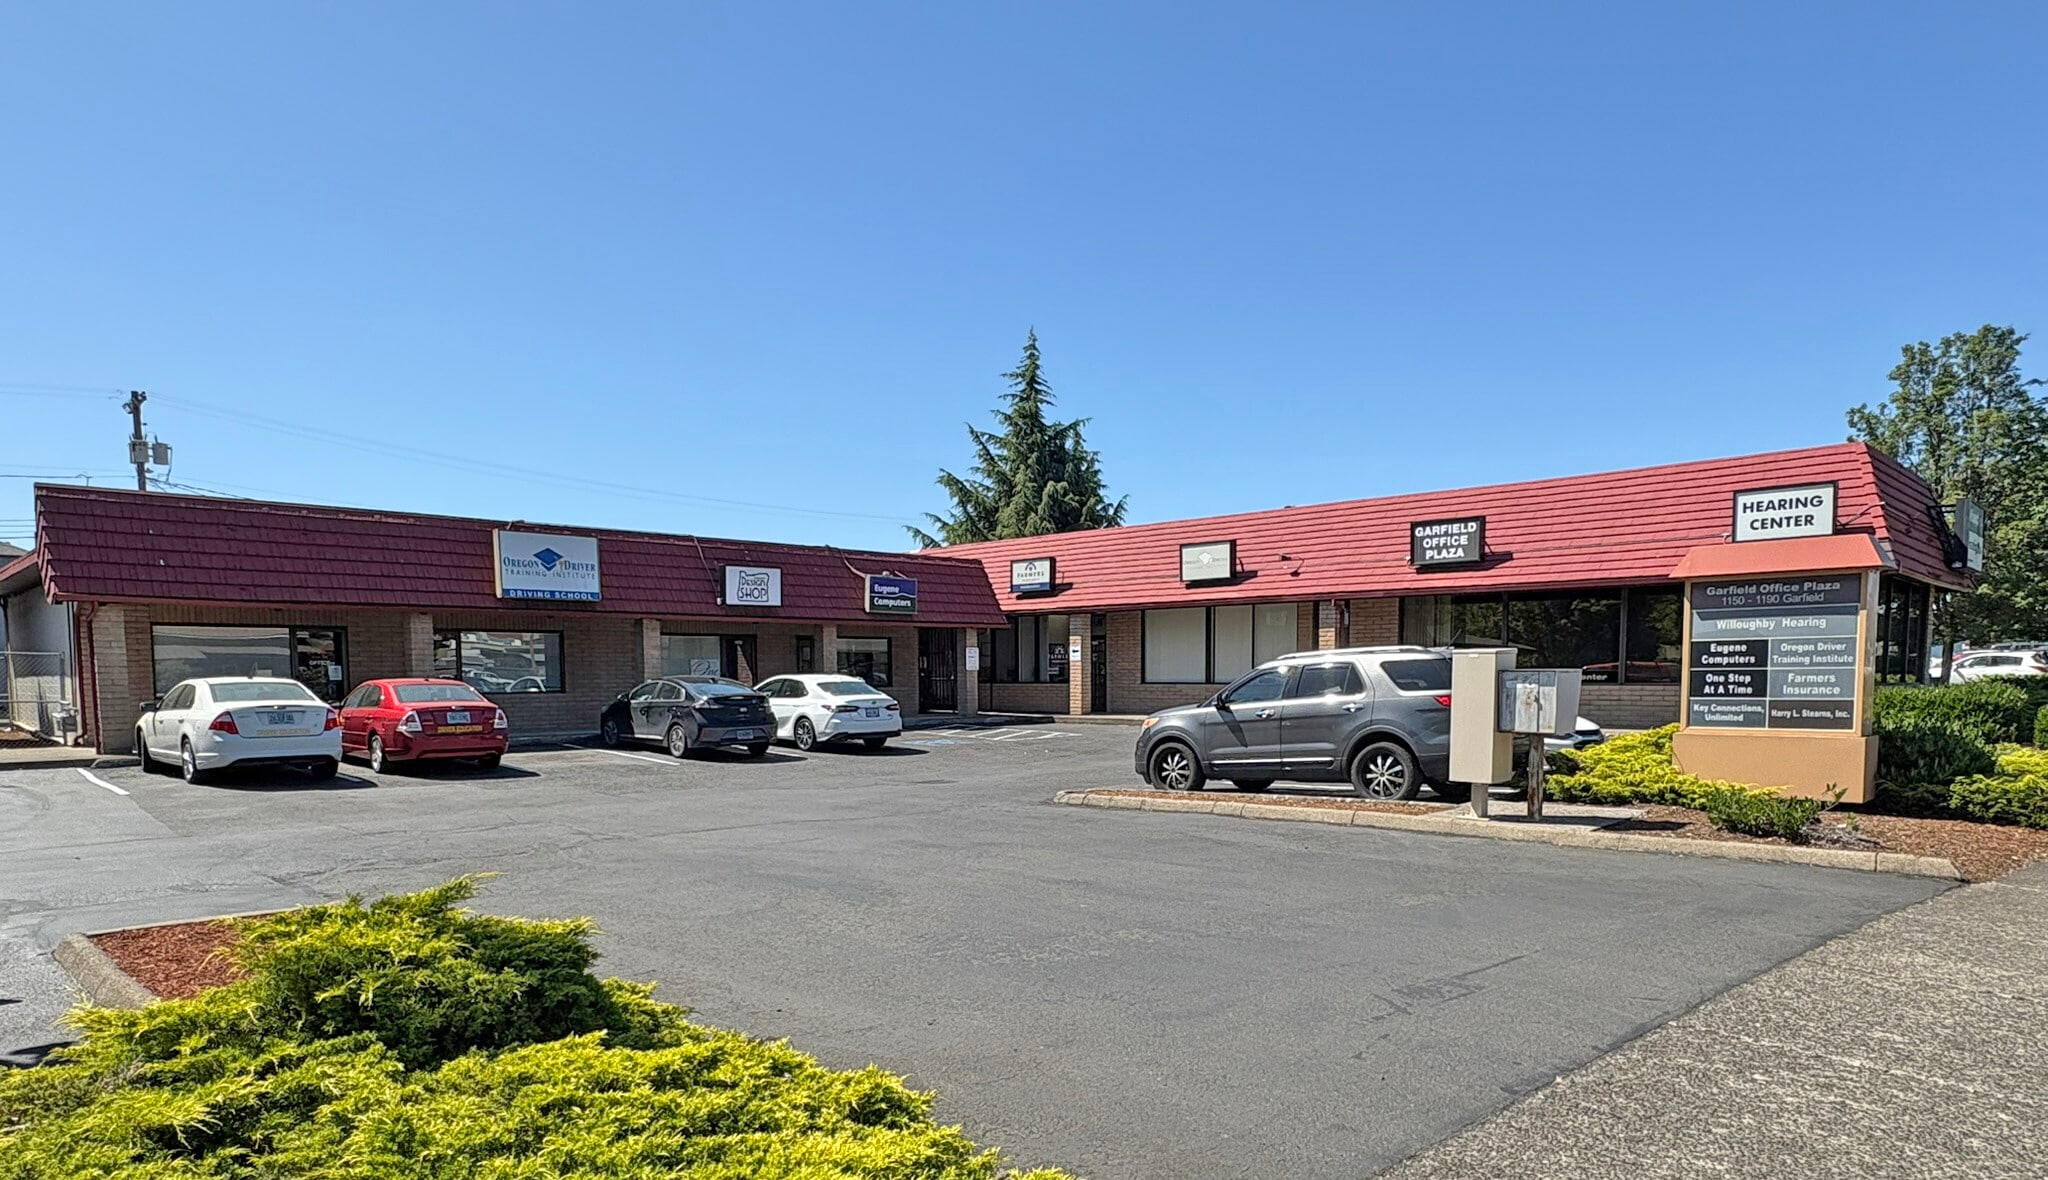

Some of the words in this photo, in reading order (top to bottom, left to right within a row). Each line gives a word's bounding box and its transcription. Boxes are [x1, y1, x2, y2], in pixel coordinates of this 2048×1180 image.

[1742, 495, 1824, 514] HEARING
[1750, 514, 1815, 530] CENTER
[1415, 522, 1477, 537] GARFIELD
[1423, 535, 1468, 548] OFFICE
[1425, 547, 1464, 560] PLAZA
[503, 557, 539, 569] OREGON
[564, 560, 596, 571] DRIVER
[505, 568, 547, 577] TRAINING
[553, 572, 595, 580] INSTITUTE
[740, 587, 767, 599] SHOP
[874, 584, 900, 594] Eugene
[1706, 584, 1756, 596] Garfield
[1760, 583, 1799, 593] Office
[1803, 581, 1840, 592] Plaza
[509, 590, 551, 598] DRIVING
[555, 592, 592, 600] SCHOOL
[1722, 596, 1745, 606] 1150
[1756, 594, 1780, 604] 1190
[1783, 592, 1825, 603] Garfield
[874, 597, 912, 608] Computers
[1716, 619, 1776, 630] Willoughby
[1782, 617, 1827, 629] Hearing
[1710, 643, 1747, 654] Eugene
[1780, 643, 1814, 653] Oregon
[1817, 642, 1847, 651] Driver
[1701, 655, 1756, 666] Computers
[1772, 655, 1810, 665] Training
[1813, 654, 1854, 664] Institute
[1705, 674, 1725, 683] One
[1728, 673, 1751, 684] Step
[1788, 673, 1836, 683] Farmers
[1703, 685, 1715, 694] At
[1717, 685, 1725, 694] A
[1728, 685, 1753, 694] Time
[1783, 685, 1841, 695] Insurance
[1693, 704, 1709, 714] Key
[1710, 704, 1765, 714] Connections,
[1835, 709, 1850, 718] Inc.
[1705, 713, 1744, 722] Unlimited
